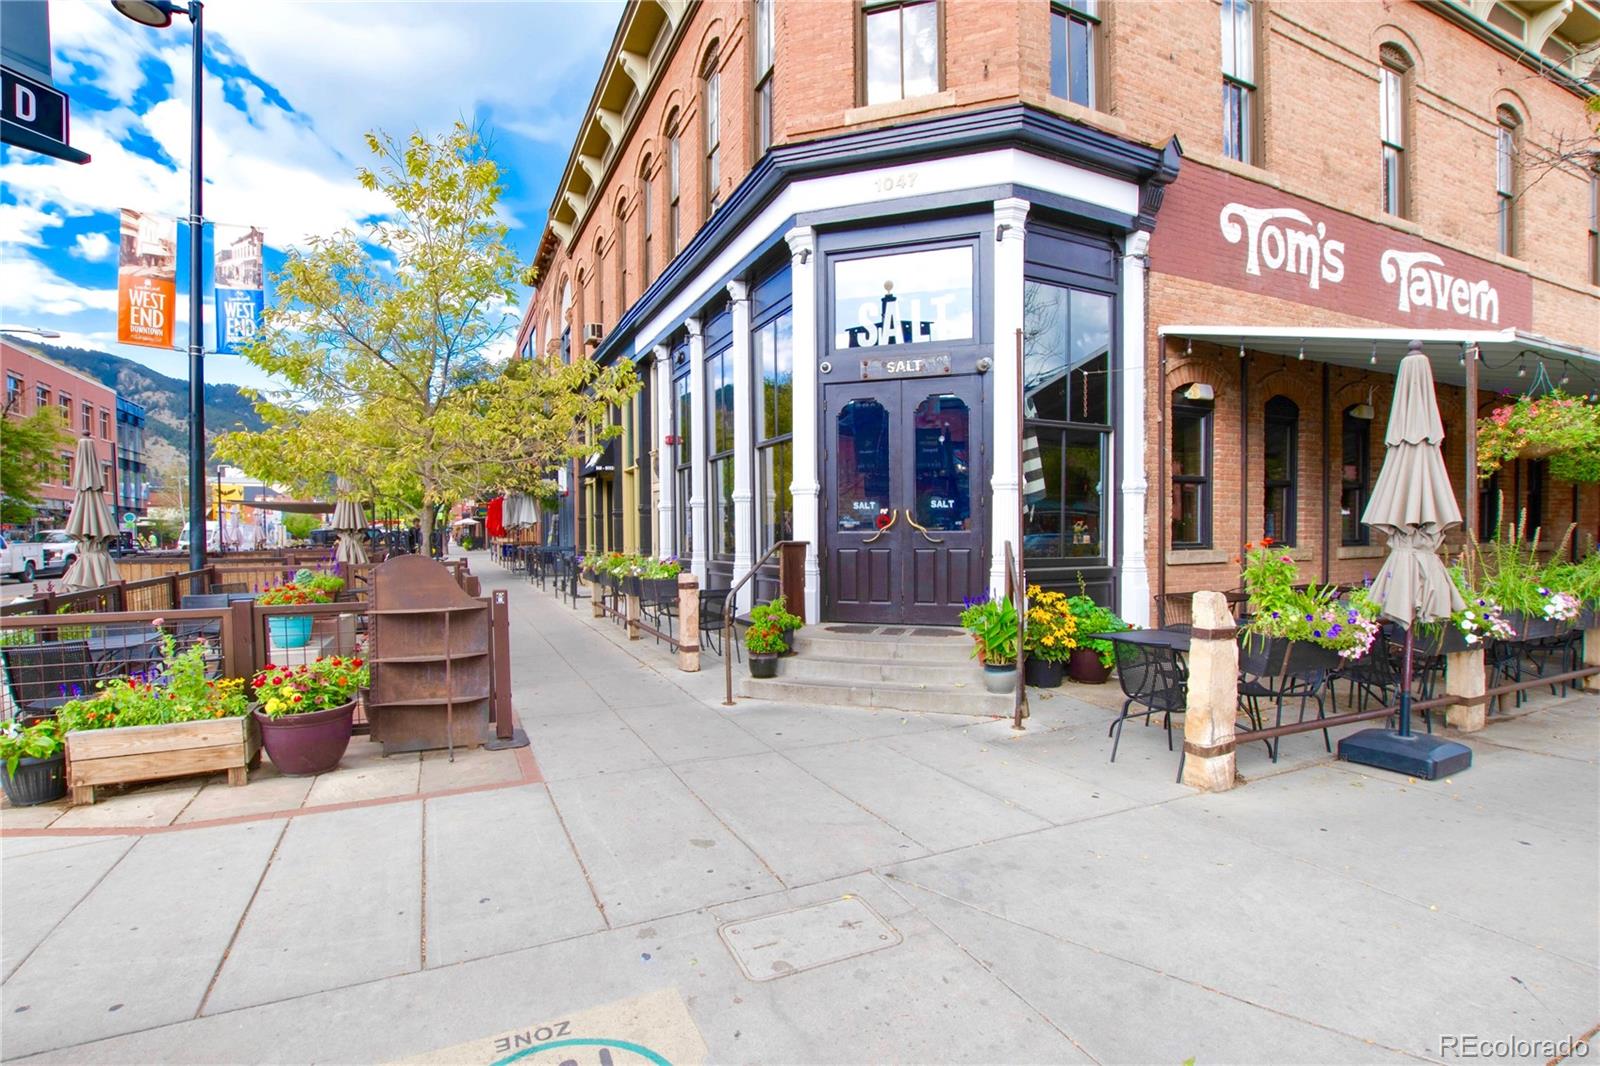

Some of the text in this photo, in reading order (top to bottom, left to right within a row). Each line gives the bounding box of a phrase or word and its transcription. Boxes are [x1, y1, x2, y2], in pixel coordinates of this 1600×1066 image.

[874, 172, 918, 193] 1047
[1219, 202, 1500, 324] Tom's Tavern
[129, 288, 166, 310] WEST
[131, 306, 164, 328] END
[223, 300, 256, 320] WEST
[857, 294, 956, 347] SALT
[226, 318, 258, 337] END
[886, 360, 922, 372] SALT
[853, 501, 876, 510] SALT
[930, 500, 955, 509] SALT
[494, 1020, 572, 1053] ZONE
